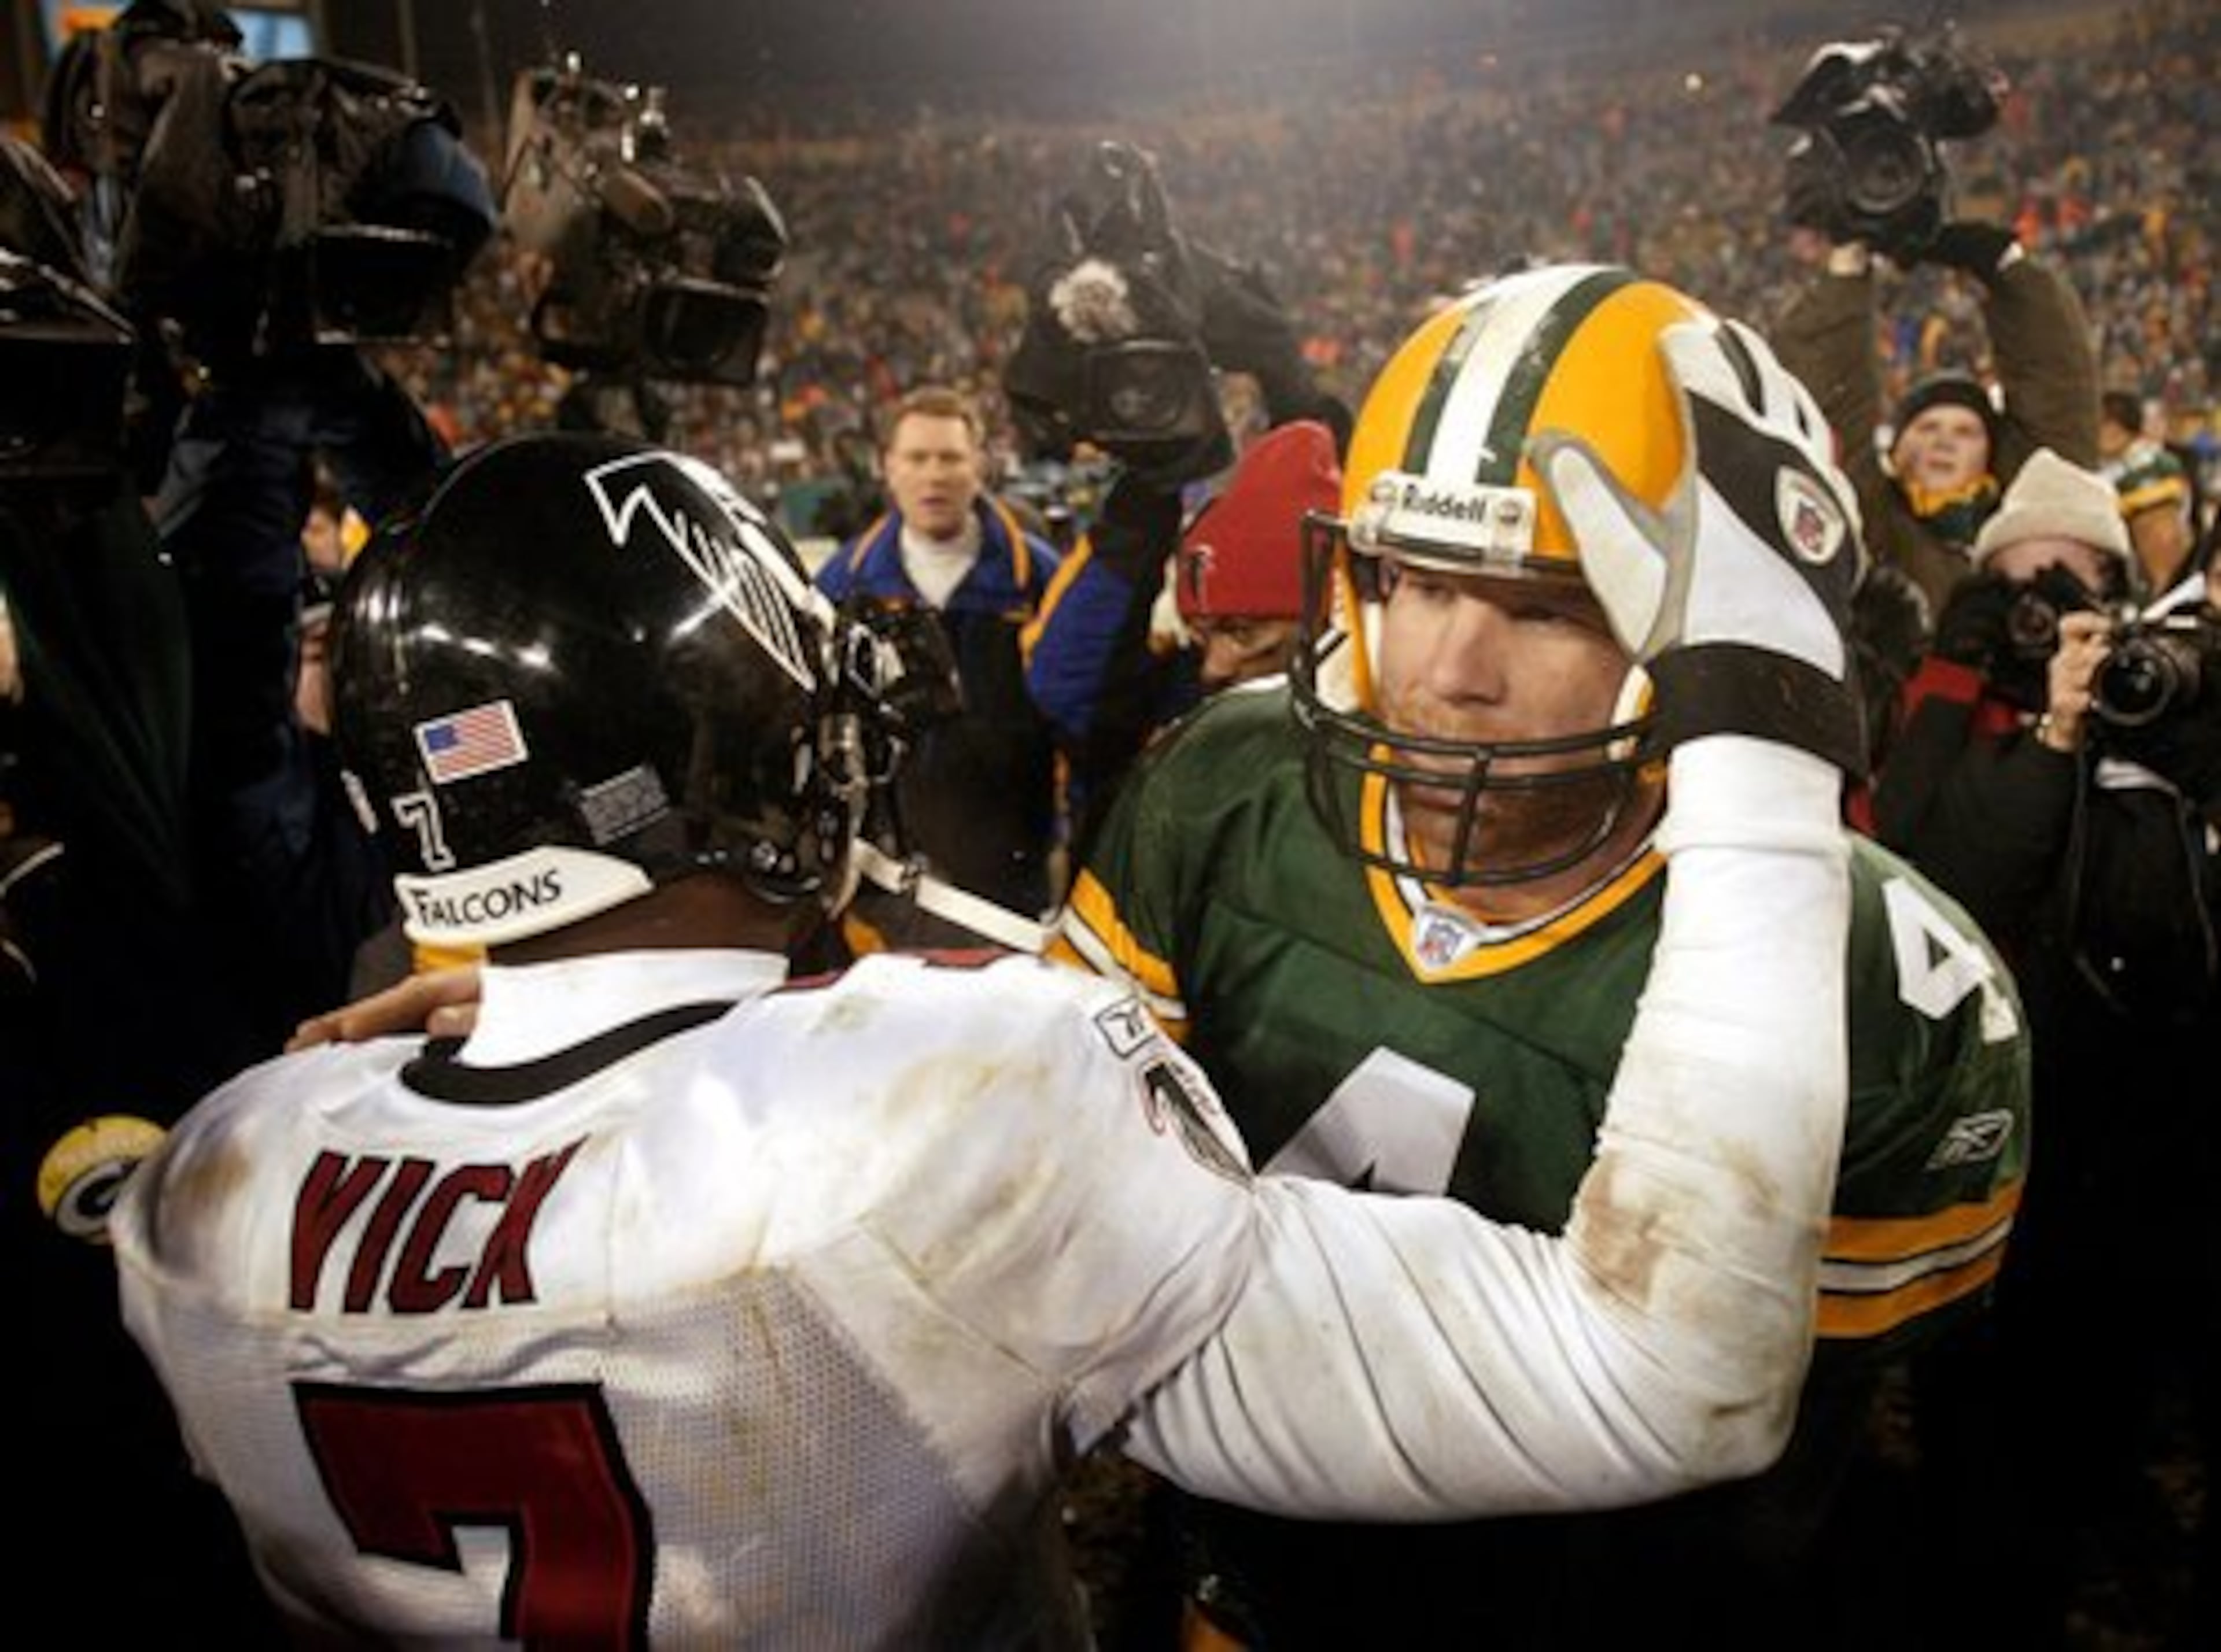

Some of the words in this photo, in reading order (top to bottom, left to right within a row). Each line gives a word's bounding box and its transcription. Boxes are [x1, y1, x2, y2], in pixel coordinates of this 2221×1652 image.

[1402, 483, 1488, 522] Riddell
[391, 790, 456, 870] 7
[411, 870, 561, 926] FALCONS
[1883, 875, 2020, 1043] 4
[289, 1133, 590, 1315] VICK
[288, 1378, 658, 1652] 7
